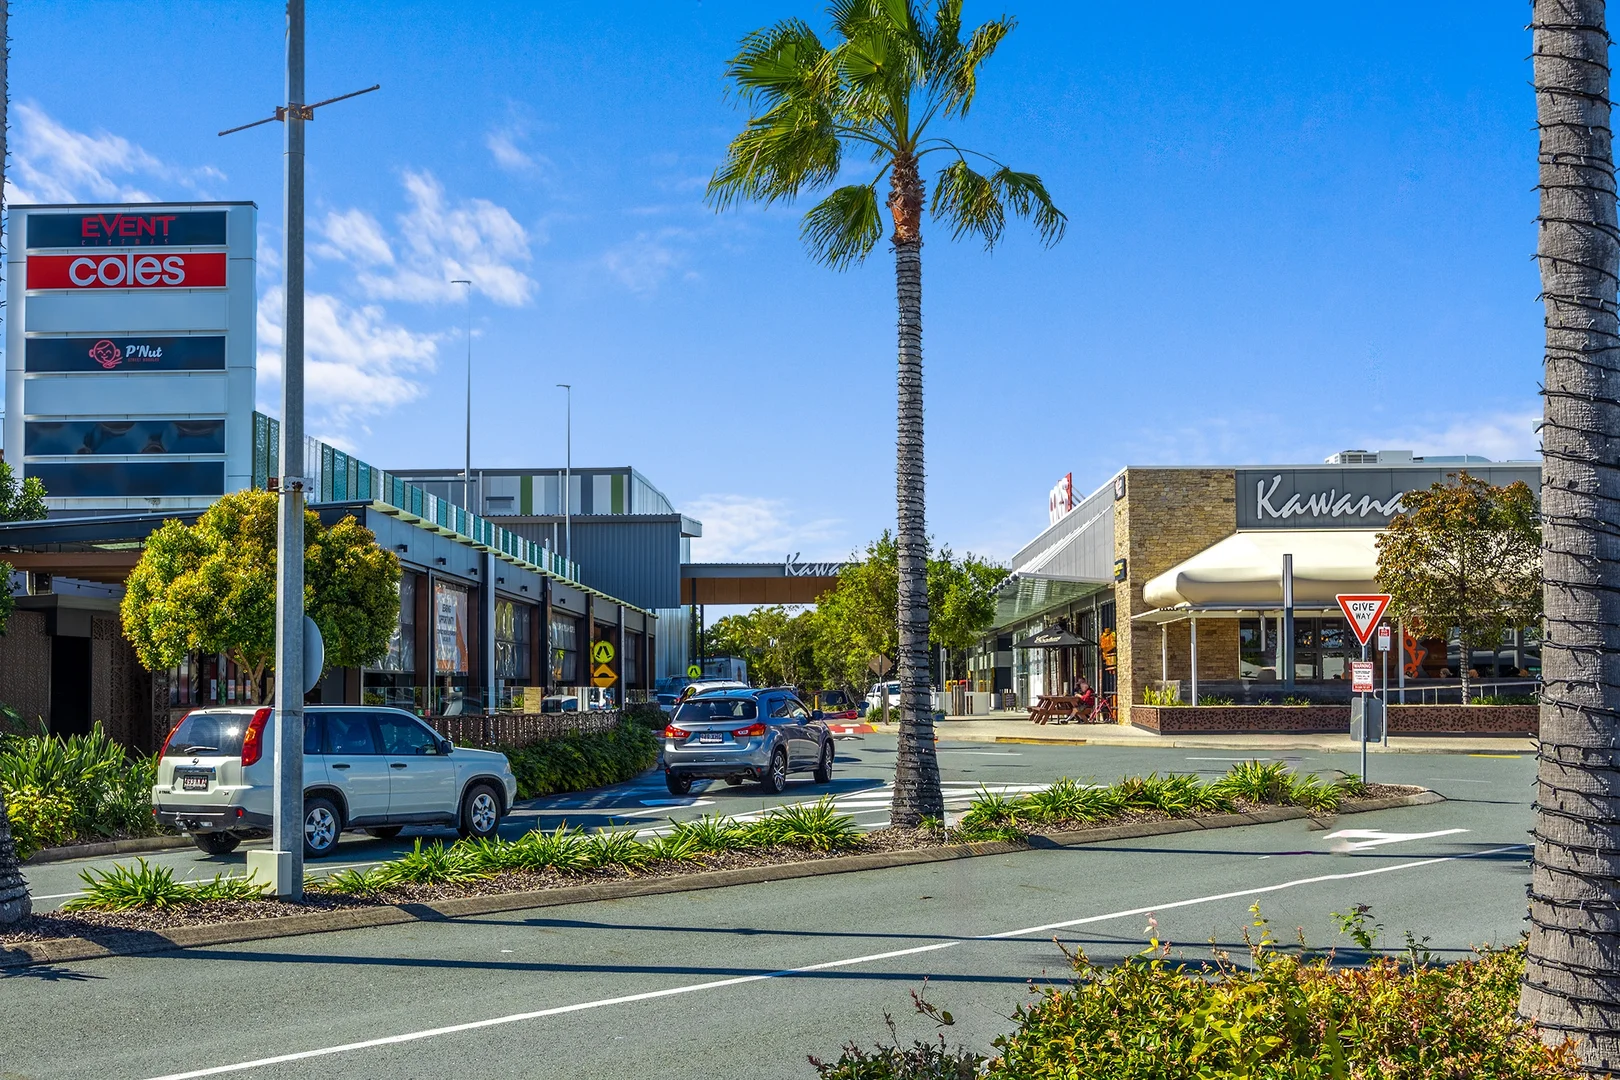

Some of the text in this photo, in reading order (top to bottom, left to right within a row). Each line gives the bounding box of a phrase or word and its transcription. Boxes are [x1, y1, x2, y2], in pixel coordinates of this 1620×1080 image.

[82, 213, 176, 237] EVENT
[69, 253, 185, 286] coles
[125, 344, 163, 358] P'Nut
[1257, 474, 1408, 519] Kawana
[785, 552, 842, 577] Kawa
[1352, 602, 1375, 612] GIVE
